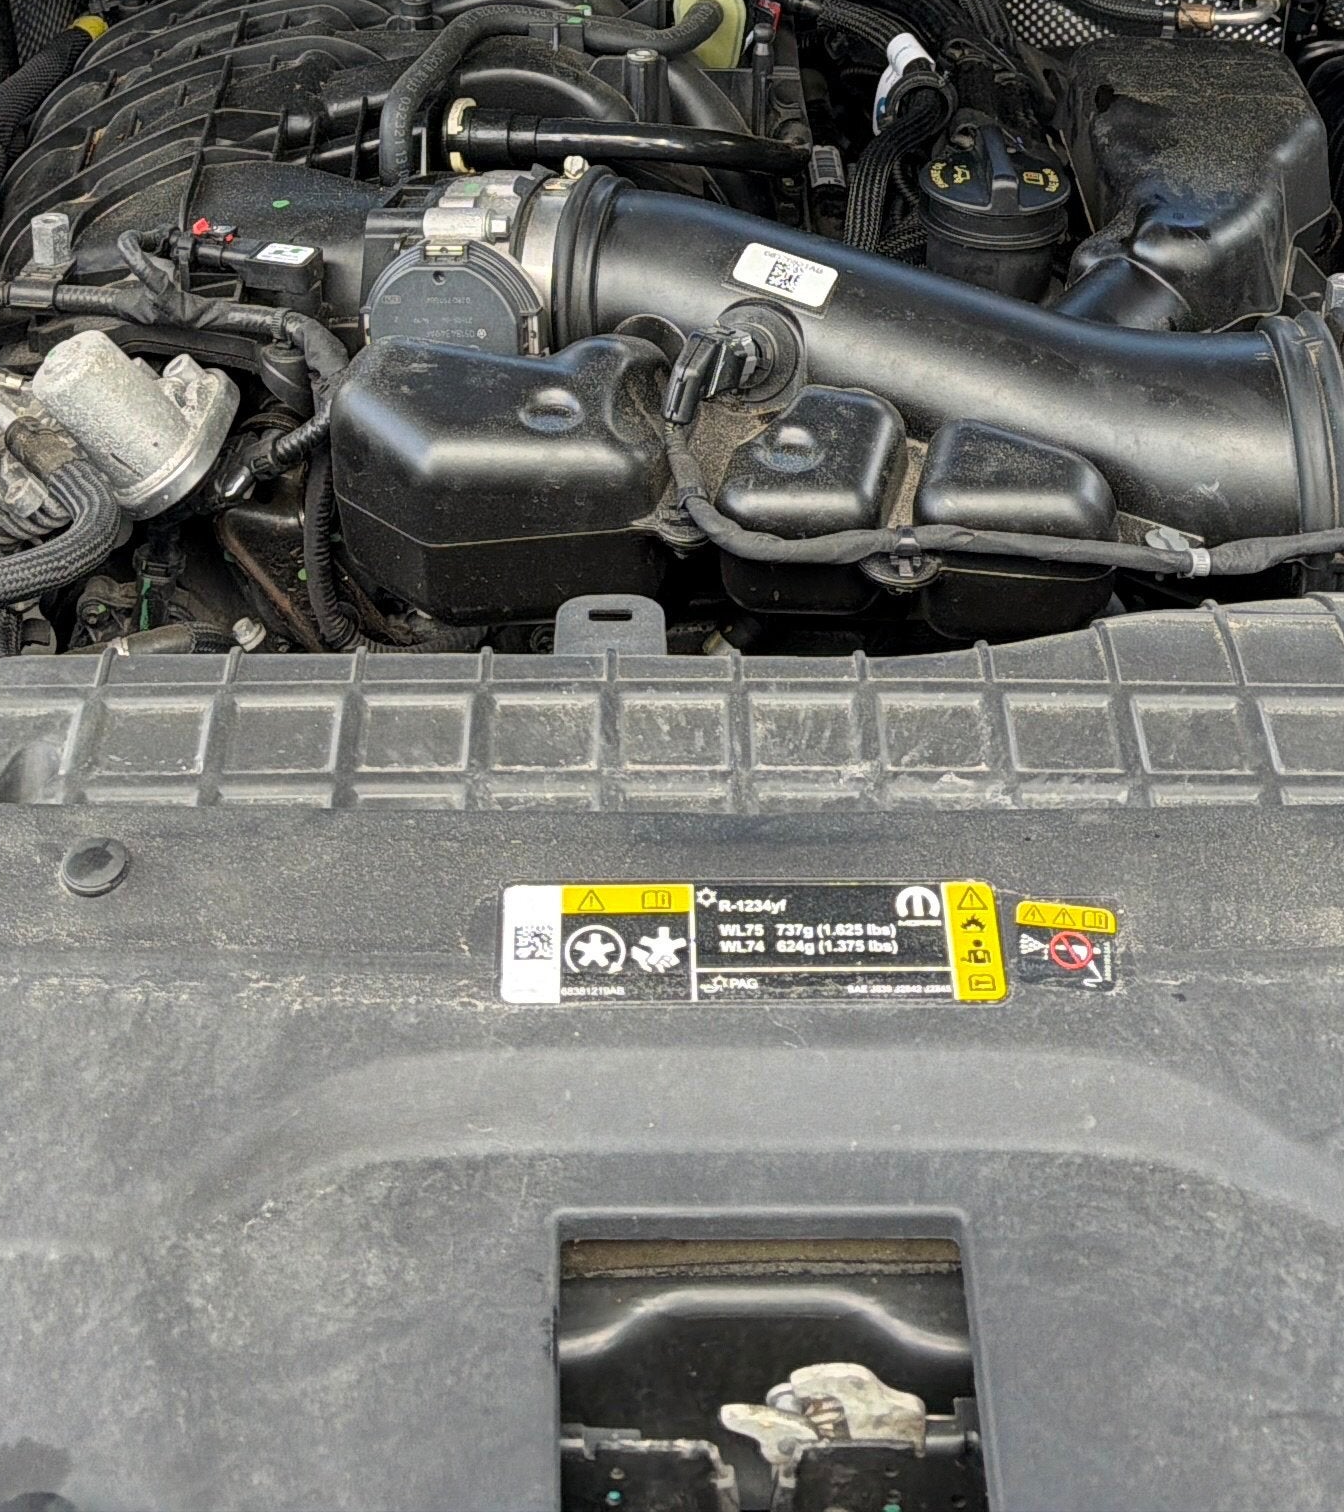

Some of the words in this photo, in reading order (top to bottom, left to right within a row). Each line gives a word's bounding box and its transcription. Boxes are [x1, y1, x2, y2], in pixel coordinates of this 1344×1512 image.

[718, 899, 787, 915] R-1234yf
[717, 923, 764, 937] WL75
[775, 923, 814, 939] 737g
[816, 923, 864, 938] (1.625
[866, 923, 897, 938] lbs)
[718, 939, 765, 954] WL74
[775, 939, 815, 955] 624g
[818, 939, 866, 955] (1.375
[868, 939, 899, 955] lbs)
[730, 978, 759, 990] PAG
